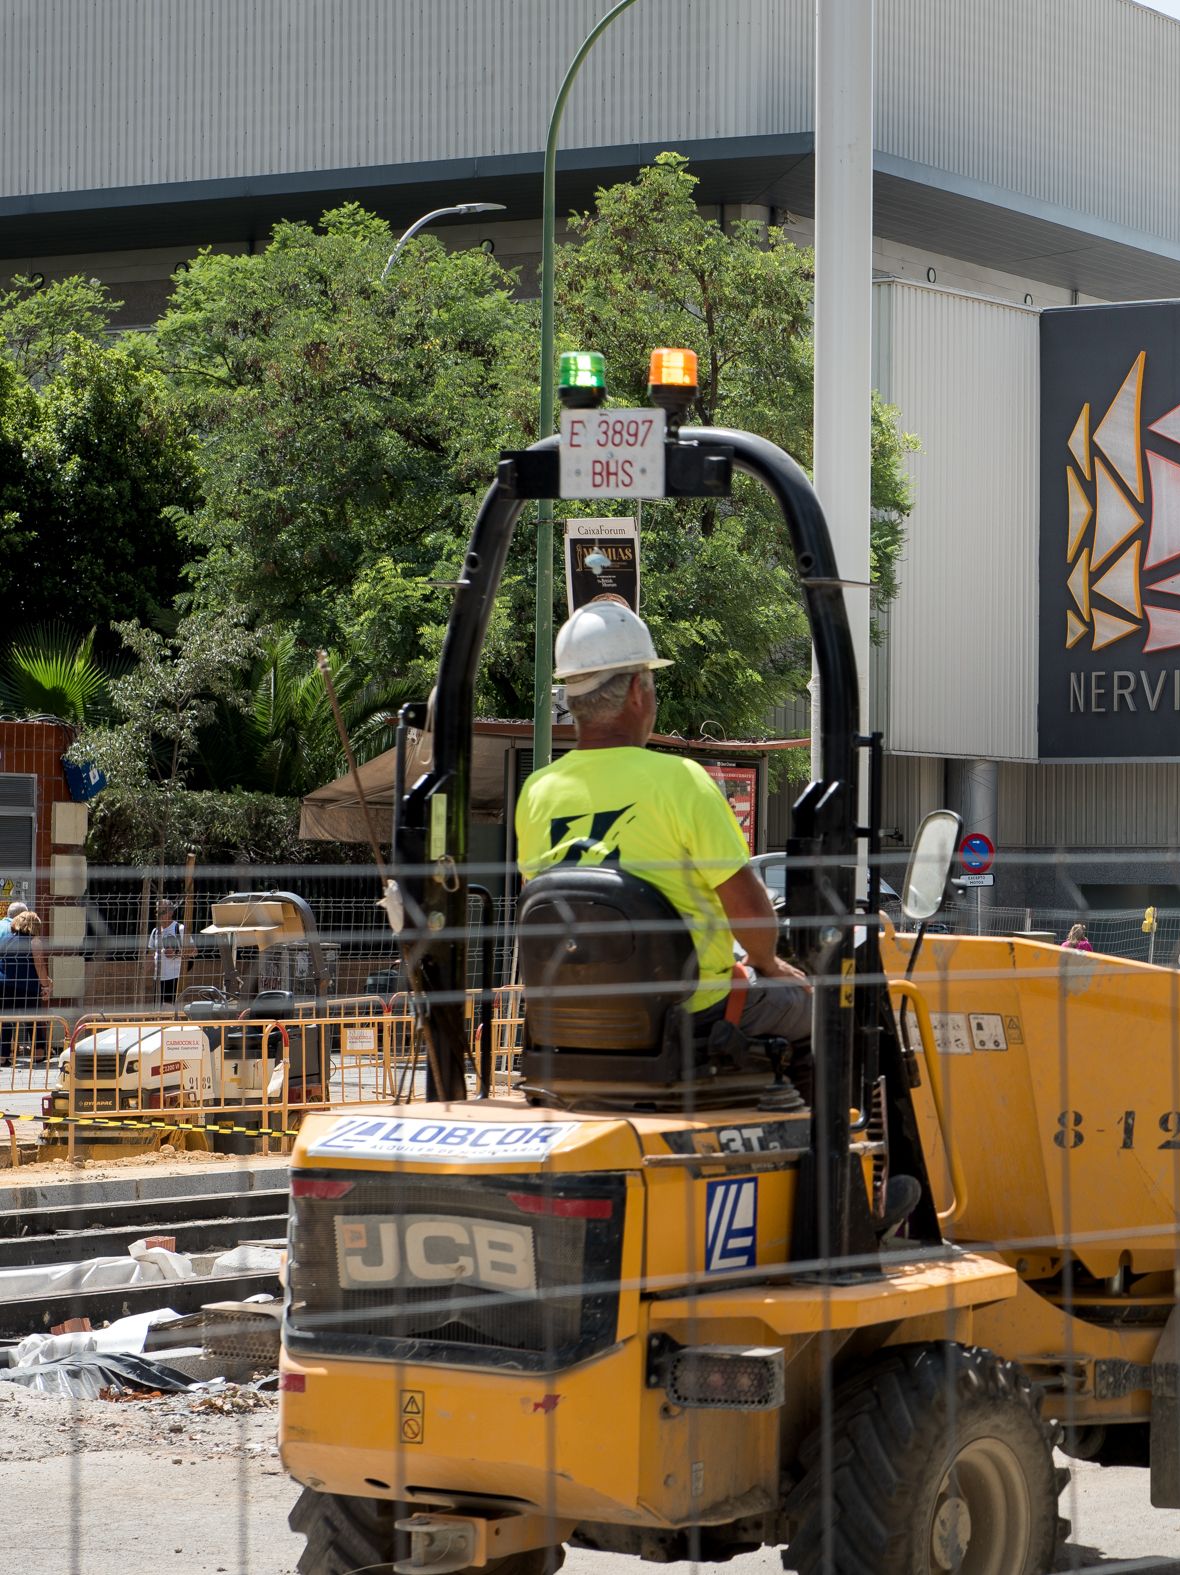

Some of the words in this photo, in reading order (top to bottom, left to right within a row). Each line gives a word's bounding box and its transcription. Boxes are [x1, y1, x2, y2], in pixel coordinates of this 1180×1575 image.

[569, 420, 584, 448] E
[596, 419, 654, 448] 3897
[591, 459, 634, 489] BHS
[577, 525, 626, 535] CaixaForum
[582, 547, 633, 560] MMIAS
[379, 1122, 559, 1147] LOBCOR
[346, 1221, 533, 1290] JCB
